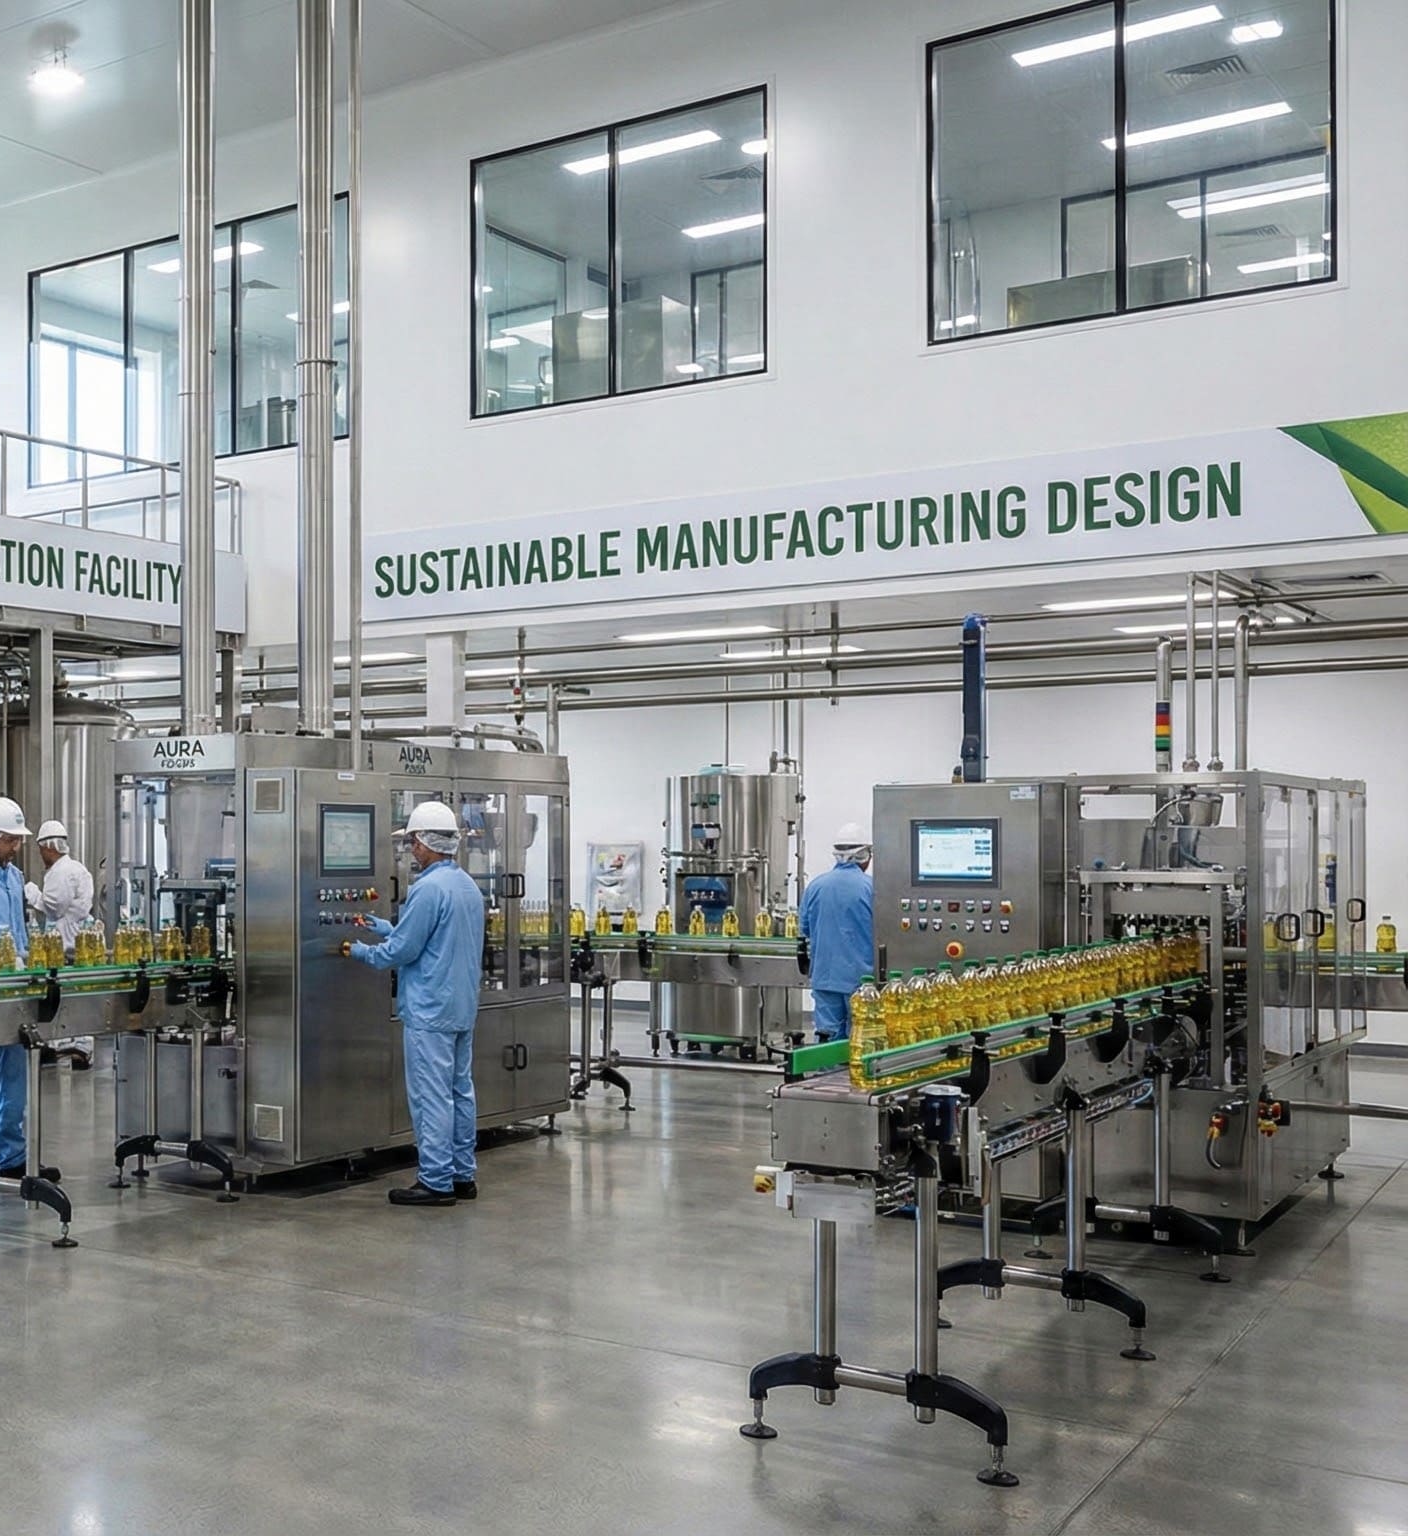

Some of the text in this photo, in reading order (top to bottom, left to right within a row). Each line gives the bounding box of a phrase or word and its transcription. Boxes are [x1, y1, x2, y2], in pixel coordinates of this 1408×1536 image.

[374, 461, 1242, 599] SUSTAINABLE MANUFACTURING DESIGN
[75, 550, 182, 604] FACILITY
[153, 740, 205, 758] AURA
